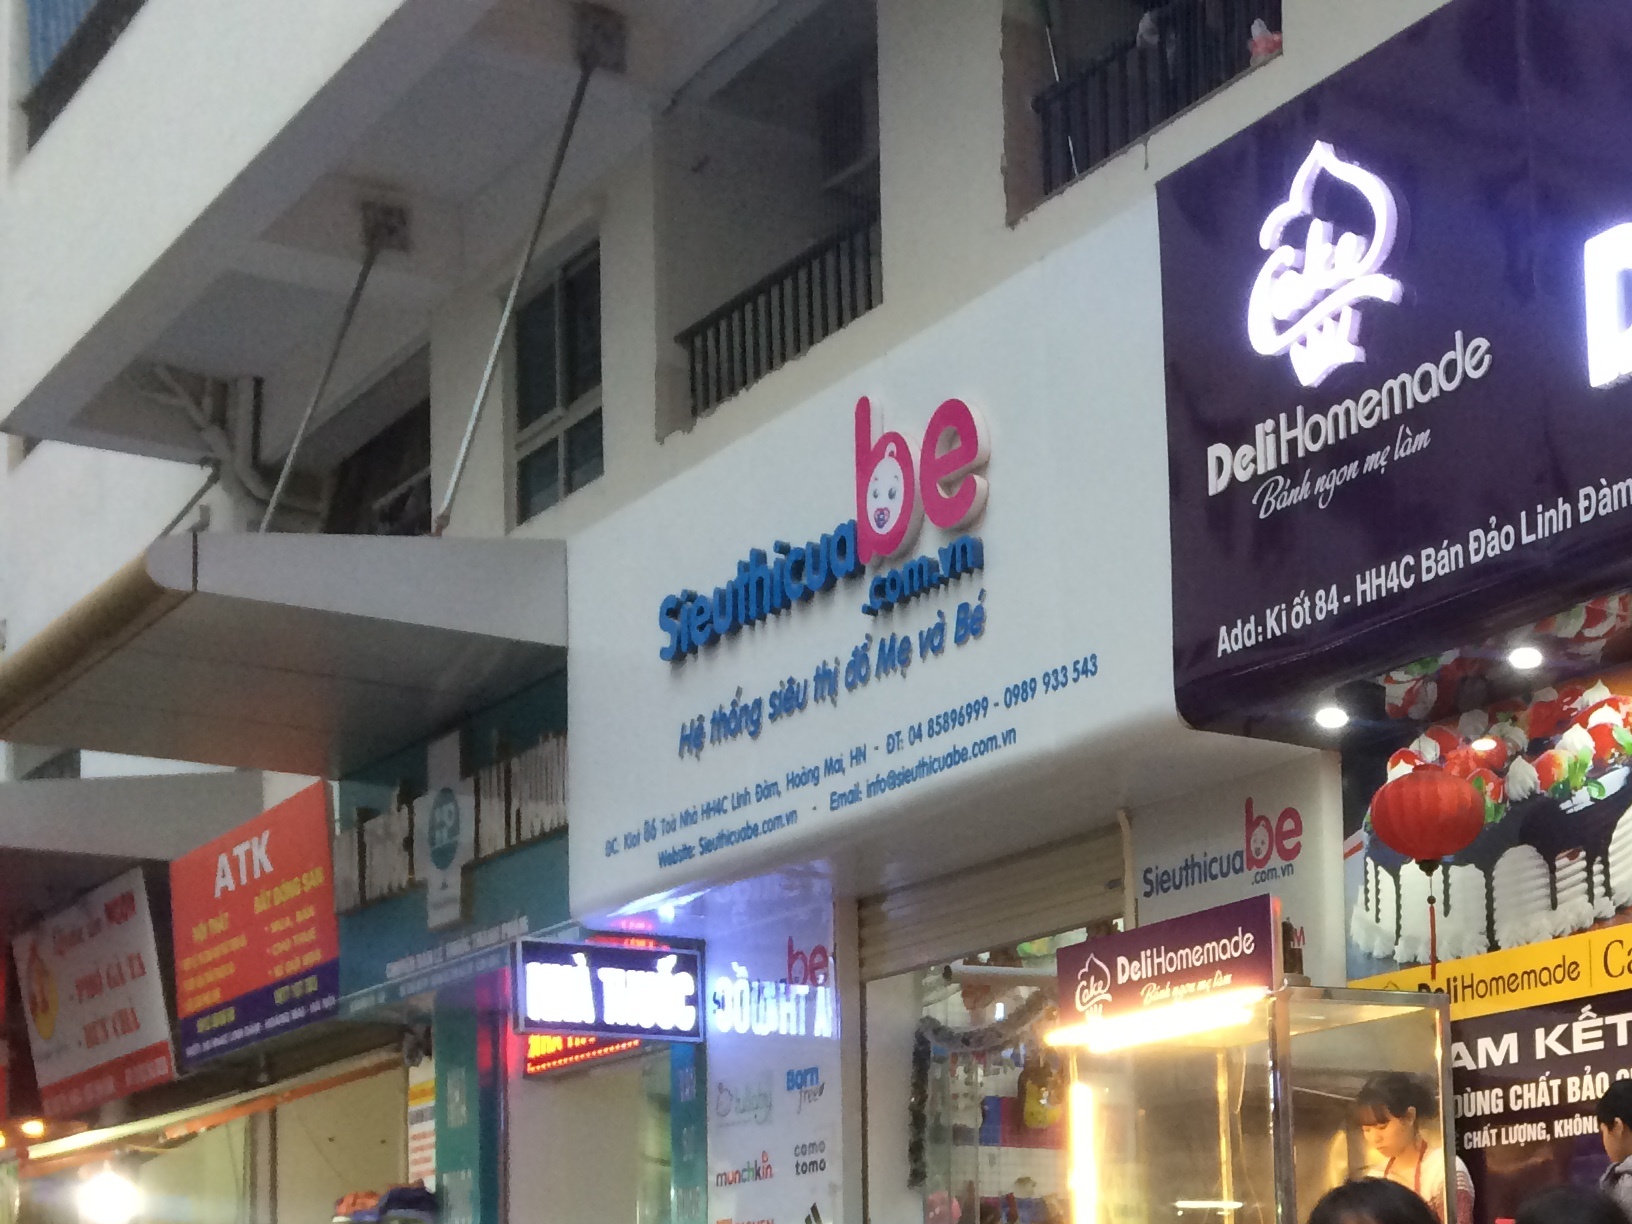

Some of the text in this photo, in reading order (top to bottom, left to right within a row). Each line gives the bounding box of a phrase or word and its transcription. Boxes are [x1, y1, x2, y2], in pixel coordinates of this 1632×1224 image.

[1252, 424, 1432, 520] Bánh ngon mẹ làm
[1315, 584, 1339, 622] 84
[1356, 555, 1415, 607] HH4C
[1421, 540, 1464, 583] Bán
[1469, 516, 1515, 565] Đảo
[1520, 497, 1572, 545] Linh
[918, 609, 946, 663] và
[954, 588, 986, 646] Bé
[908, 722, 923, 745] 04
[1004, 677, 1038, 708] 0989
[1043, 664, 1069, 695] 933
[1072, 653, 1099, 683] 543
[214, 829, 274, 899] ATK
[1451, 1032, 1519, 1071] AM
[1509, 1071, 1561, 1112] CHẤT
[1567, 1065, 1610, 1102] BẢO
[795, 1158, 827, 1175] tomo
[1463, 1122, 1497, 1150] CHẤT
